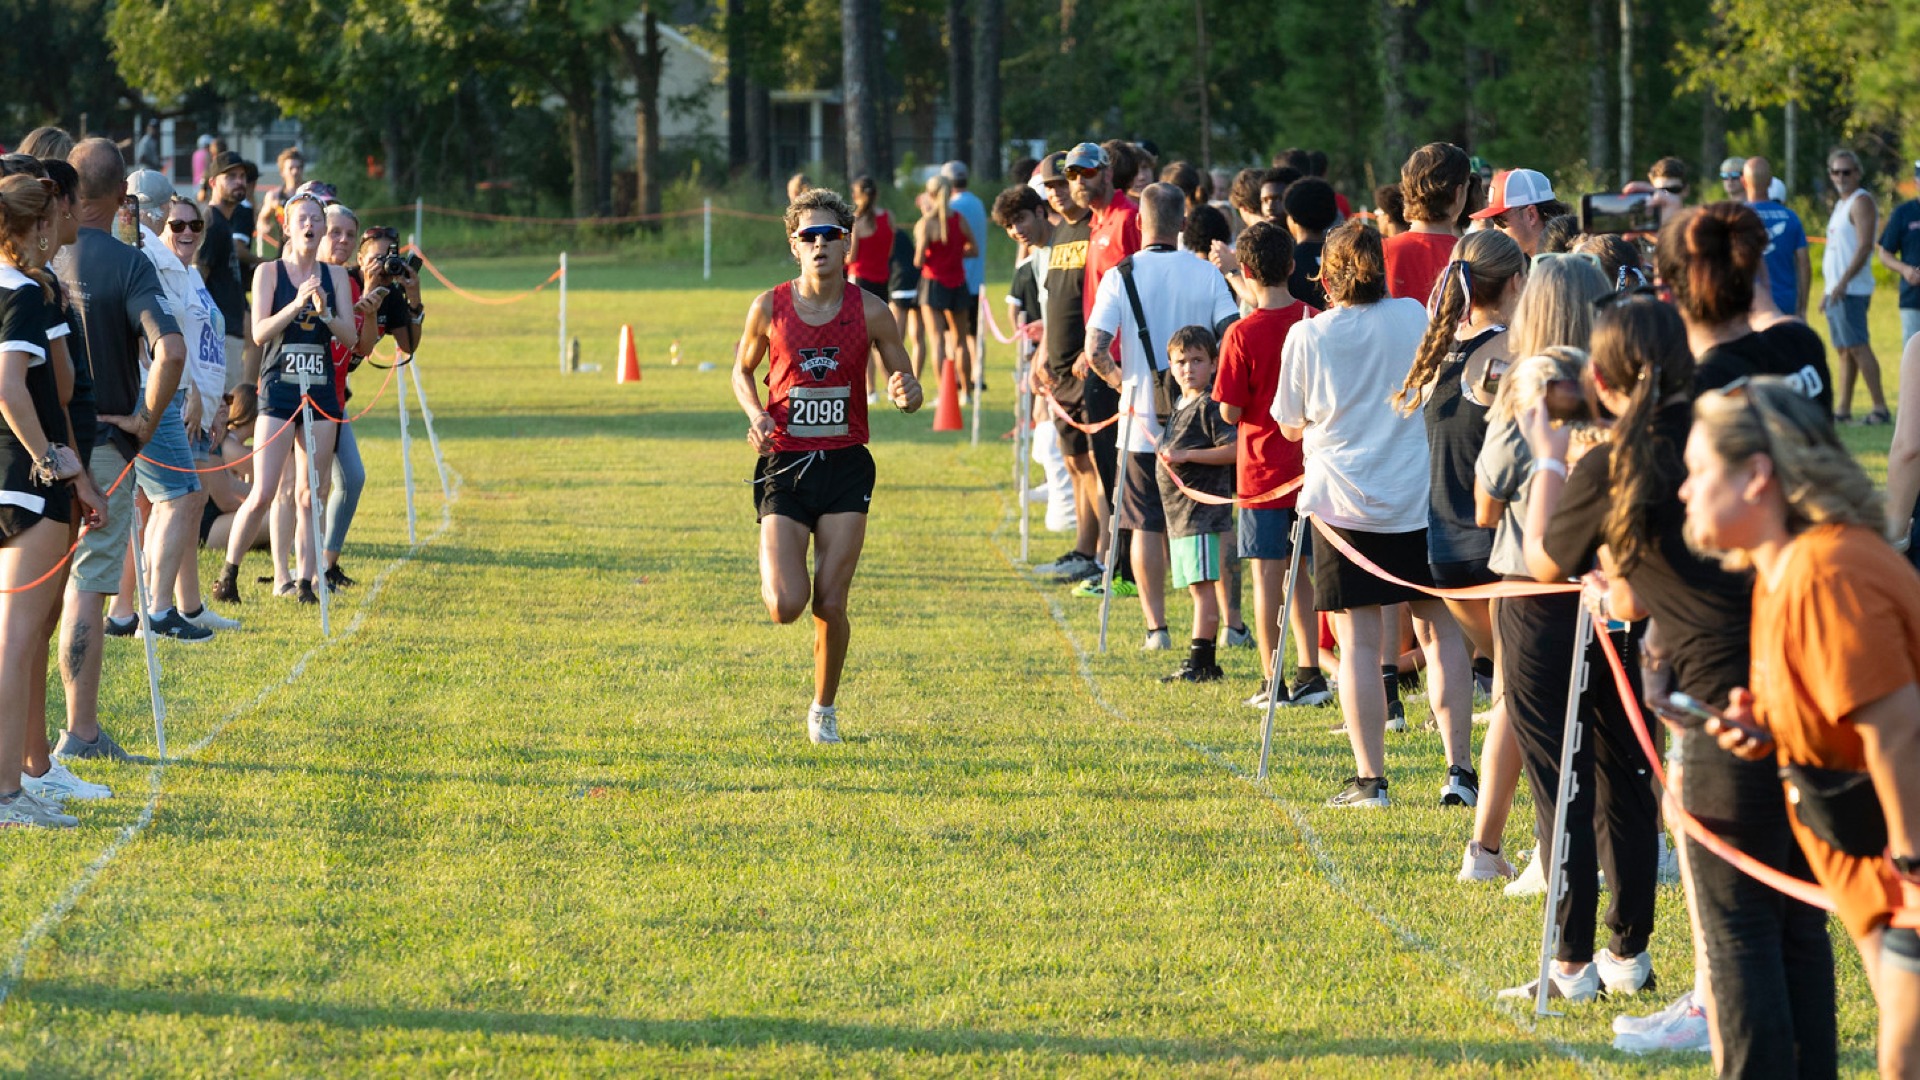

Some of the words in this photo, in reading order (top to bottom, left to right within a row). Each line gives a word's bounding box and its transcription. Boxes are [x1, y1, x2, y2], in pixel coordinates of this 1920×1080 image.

[286, 353, 324, 374] 2045
[806, 358, 832, 366] STATE
[793, 399, 845, 424] 2098
